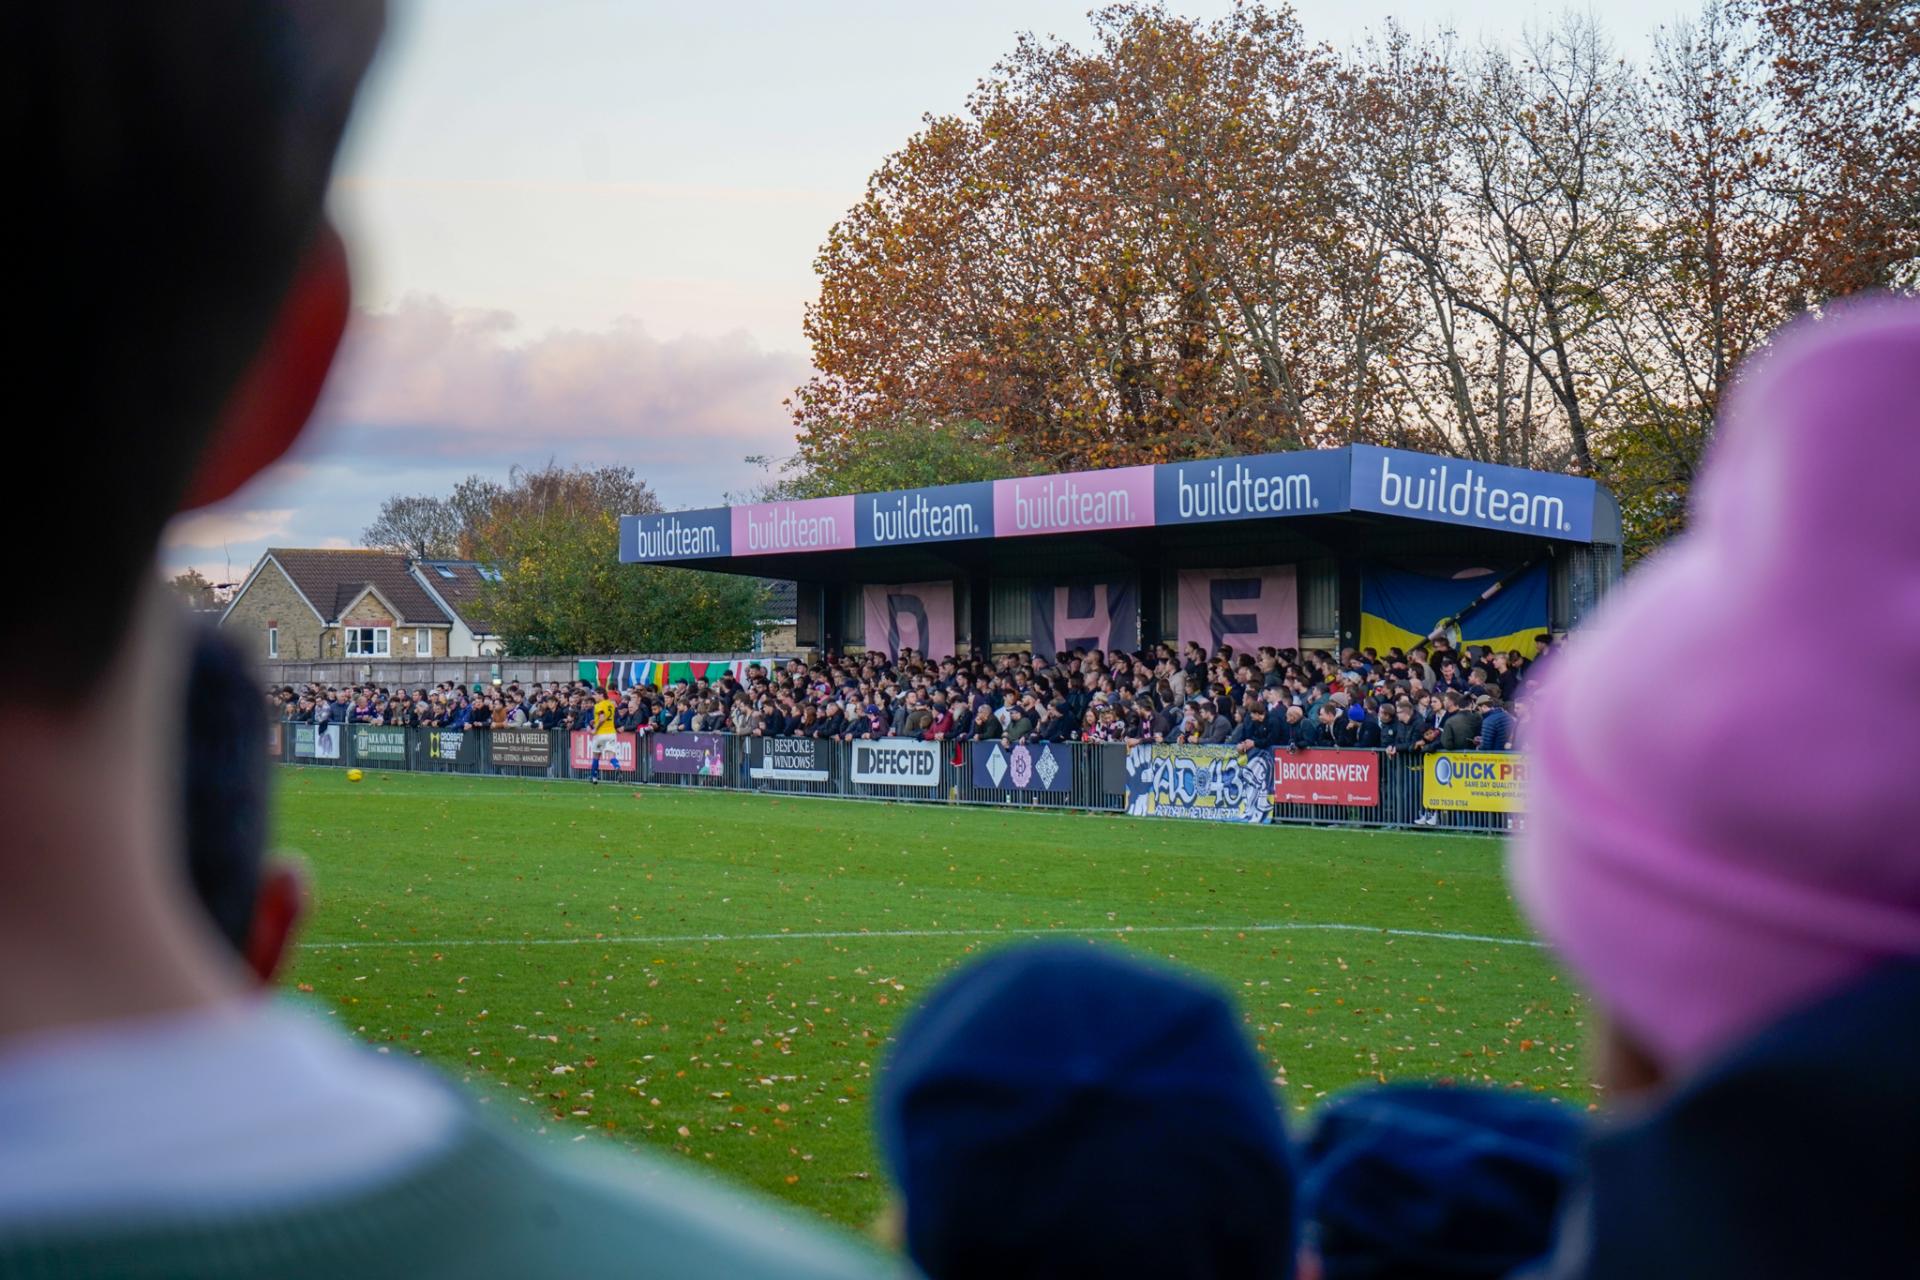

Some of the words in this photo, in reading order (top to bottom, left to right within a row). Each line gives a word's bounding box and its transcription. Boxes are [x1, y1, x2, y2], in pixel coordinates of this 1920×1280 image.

[887, 593, 930, 661] D
[1054, 584, 1112, 655] H
[440, 741, 462, 750] TWENTY
[492, 732, 515, 744] HARVEY
[521, 733, 548, 745] WHEELER
[774, 738, 810, 754] BESPOKE
[440, 750, 457, 759] THREE
[774, 755, 811, 769] WINDOWS
[857, 747, 935, 776] DEFECTED
[1283, 762, 1313, 780] BRICK
[1315, 764, 1370, 782] BREWERY
[1435, 756, 1497, 788] QUICK
